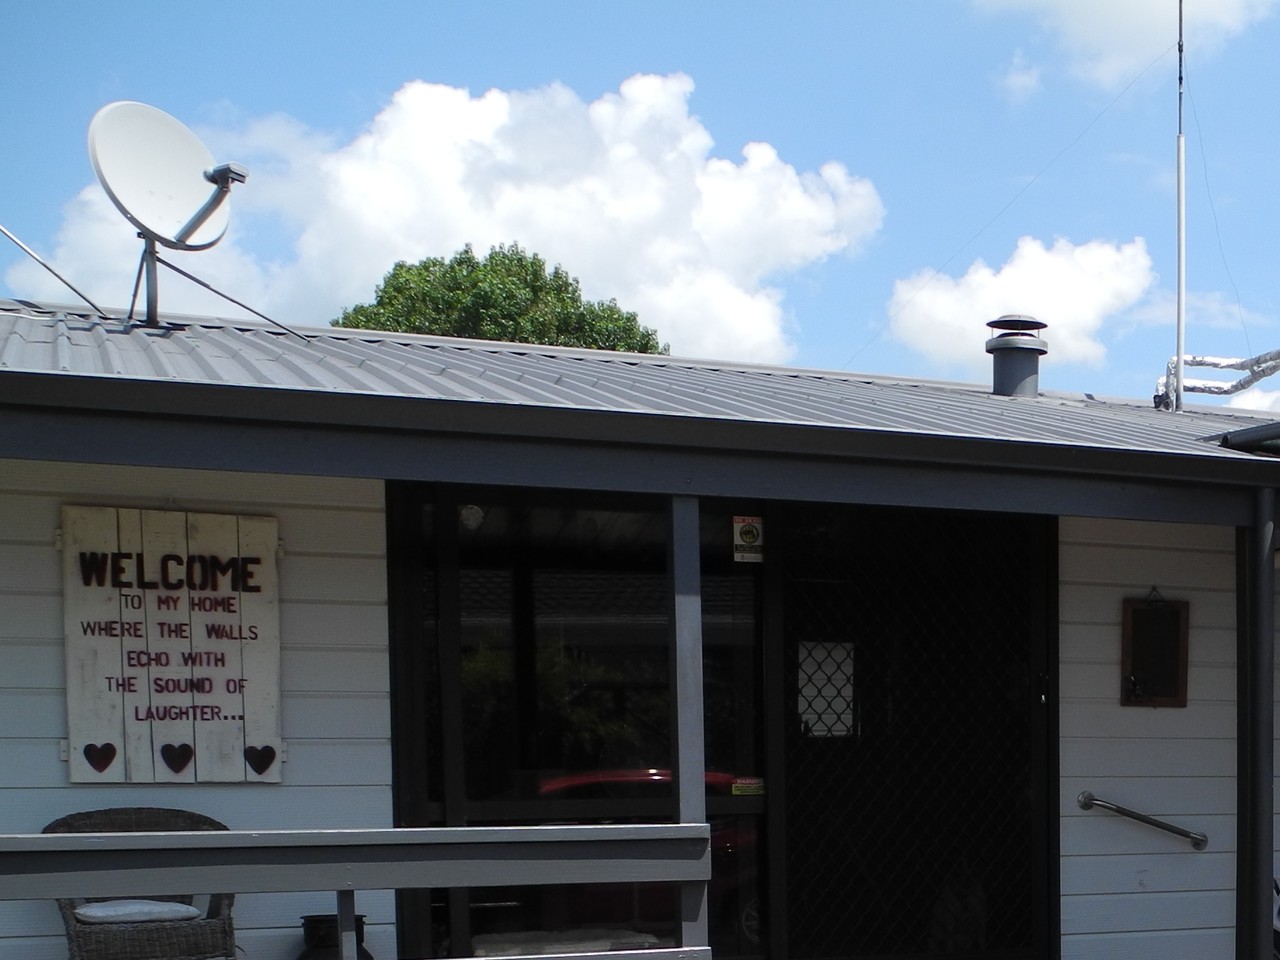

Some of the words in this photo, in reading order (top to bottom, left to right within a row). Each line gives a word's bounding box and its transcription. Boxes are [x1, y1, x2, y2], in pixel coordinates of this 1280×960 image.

[80, 551, 262, 592] WELCOME
[121, 594, 142, 610] TO
[157, 596, 180, 611] MY
[191, 597, 237, 613] HOME
[81, 621, 143, 638] WHERE
[157, 622, 189, 639] THE
[206, 625, 258, 640] WALLS
[127, 651, 169, 667] ECHO
[182, 653, 225, 667] WITH
[105, 677, 137, 692] THE
[154, 678, 212, 694] SOUND
[226, 679, 248, 694] OF
[135, 706, 244, 721] LAUGHTER...
